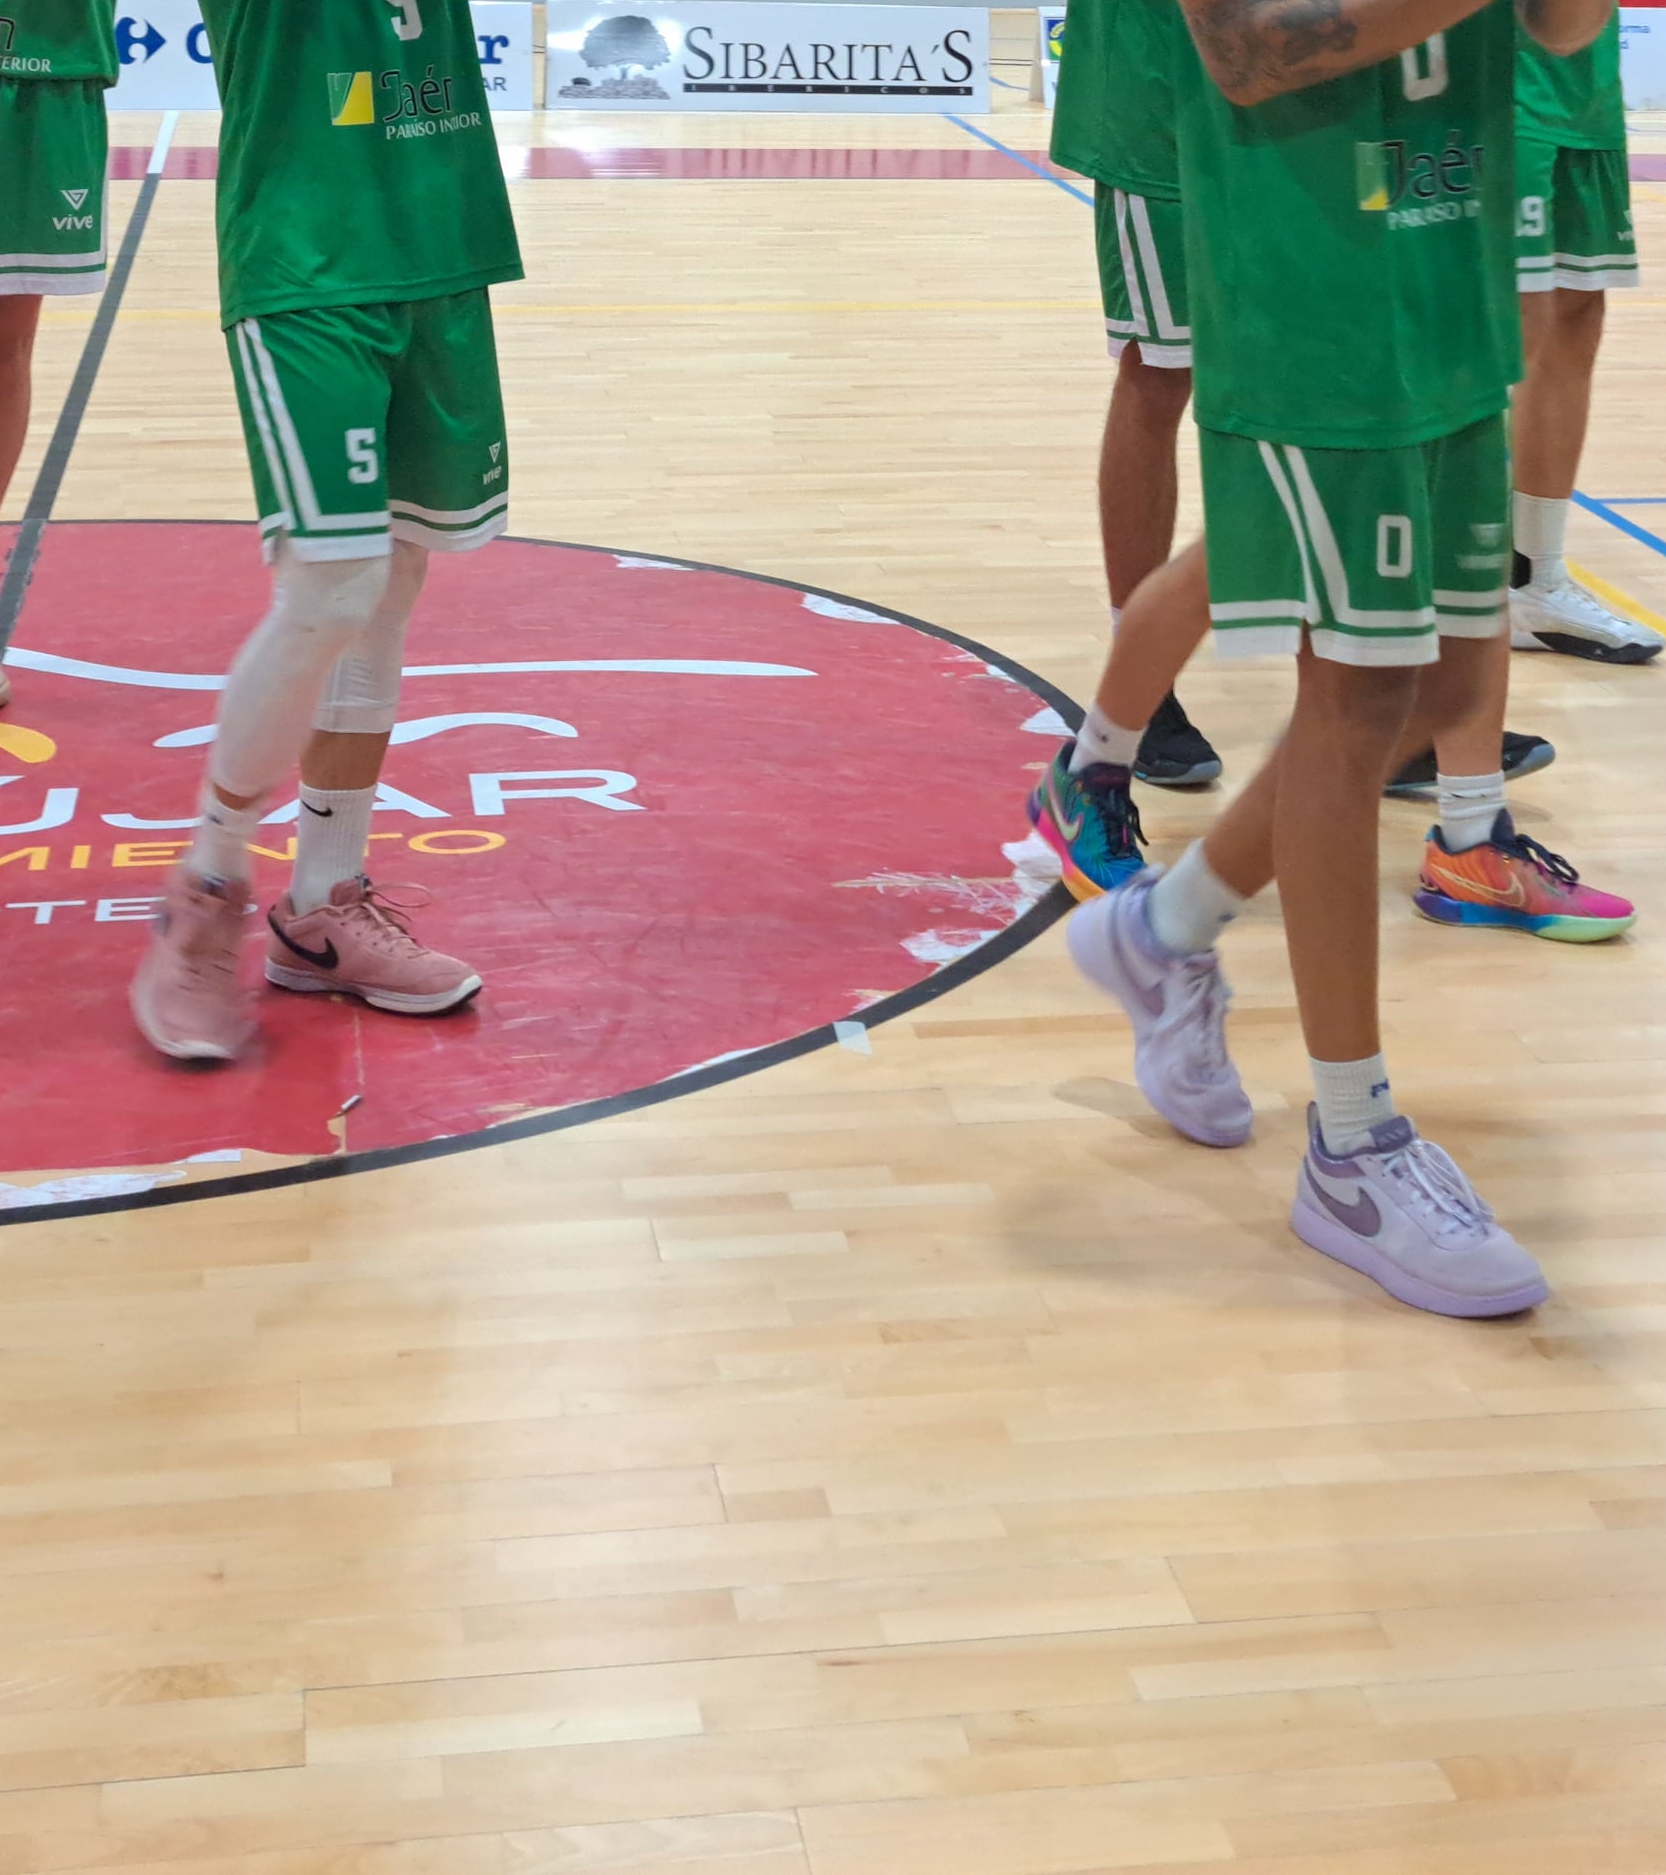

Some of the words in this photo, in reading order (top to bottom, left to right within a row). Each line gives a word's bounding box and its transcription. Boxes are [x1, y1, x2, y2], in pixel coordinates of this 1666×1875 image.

[52, 213, 93, 230] vive
[344, 427, 379, 484] 5
[1376, 514, 1412, 578] 0
